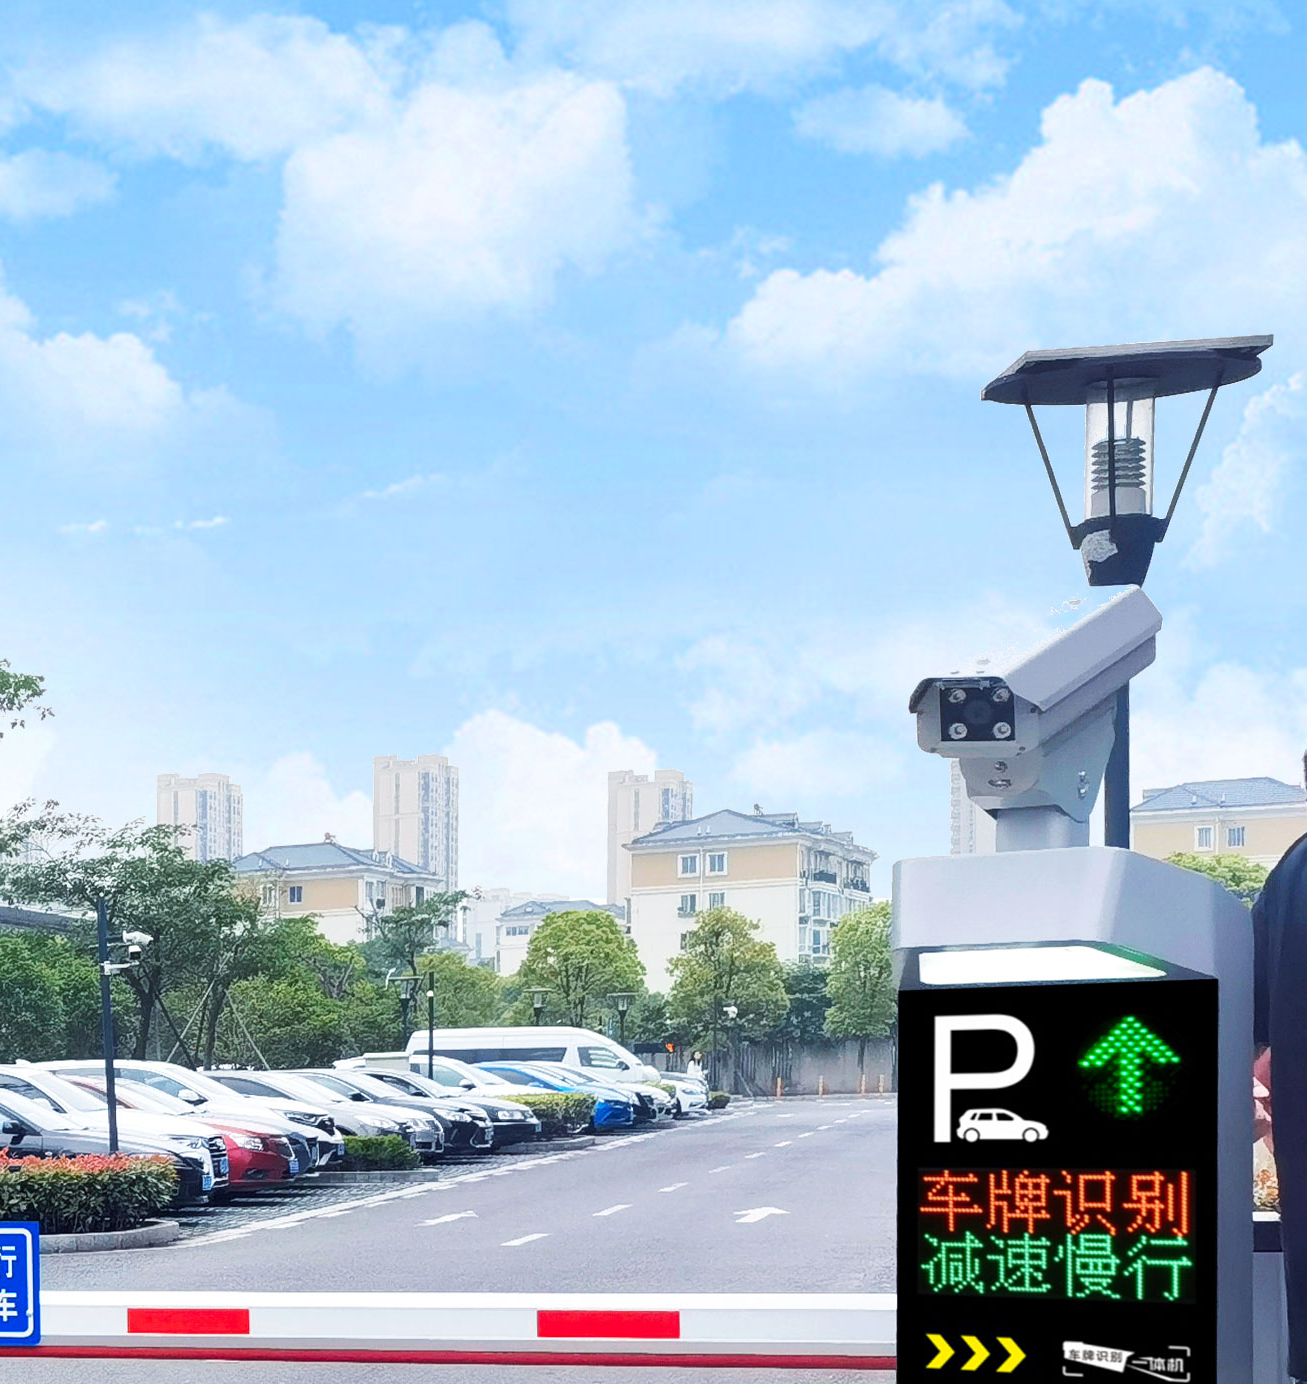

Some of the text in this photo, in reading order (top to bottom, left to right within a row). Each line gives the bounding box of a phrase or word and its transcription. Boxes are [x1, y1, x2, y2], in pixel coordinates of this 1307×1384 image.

[933, 1013, 1036, 1143] P
[920, 1170, 1189, 1237] 车牌识别
[920, 1231, 1193, 1301] 减速慢行
[1068, 1348, 1185, 1373] 车牌识别 一体机
